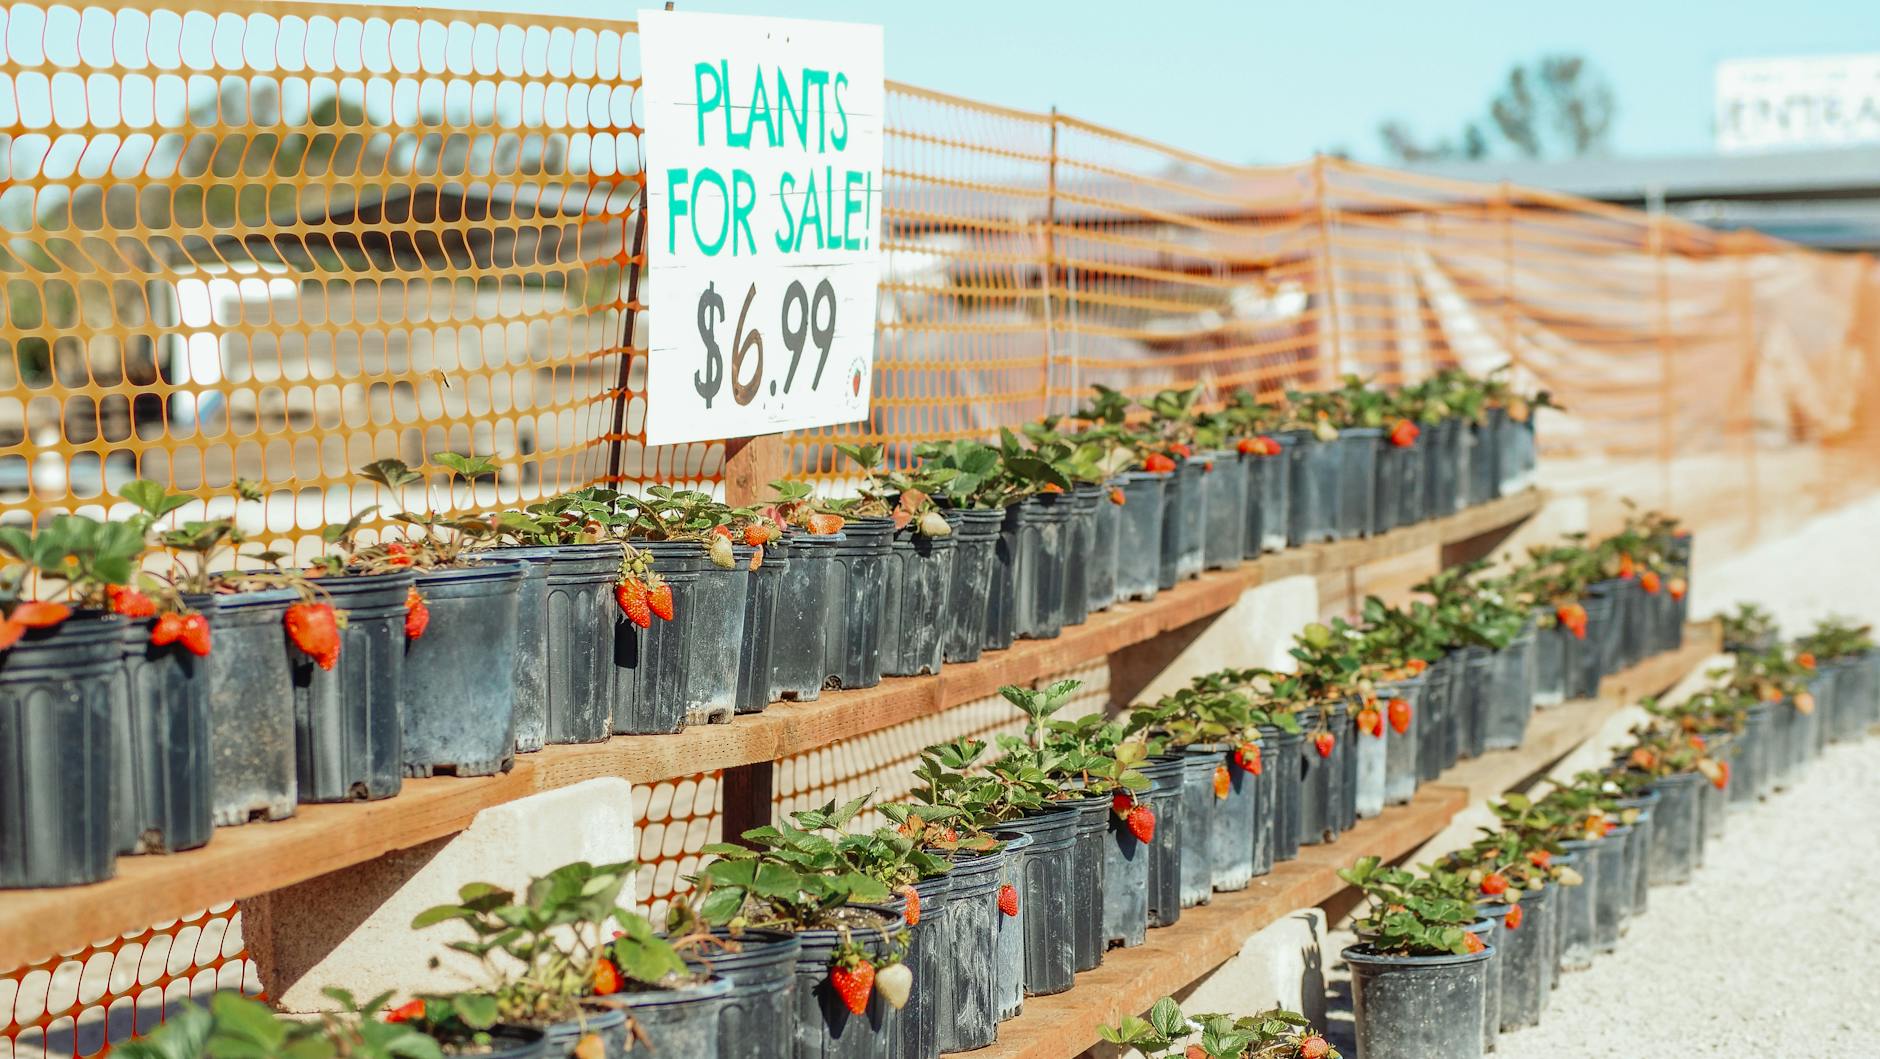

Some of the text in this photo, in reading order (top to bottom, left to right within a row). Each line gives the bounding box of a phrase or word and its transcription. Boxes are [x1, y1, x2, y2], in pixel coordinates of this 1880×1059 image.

[695, 59, 848, 153] PLANTS
[667, 166, 872, 256] FOR SALE!
[694, 278, 837, 409] $6.99
